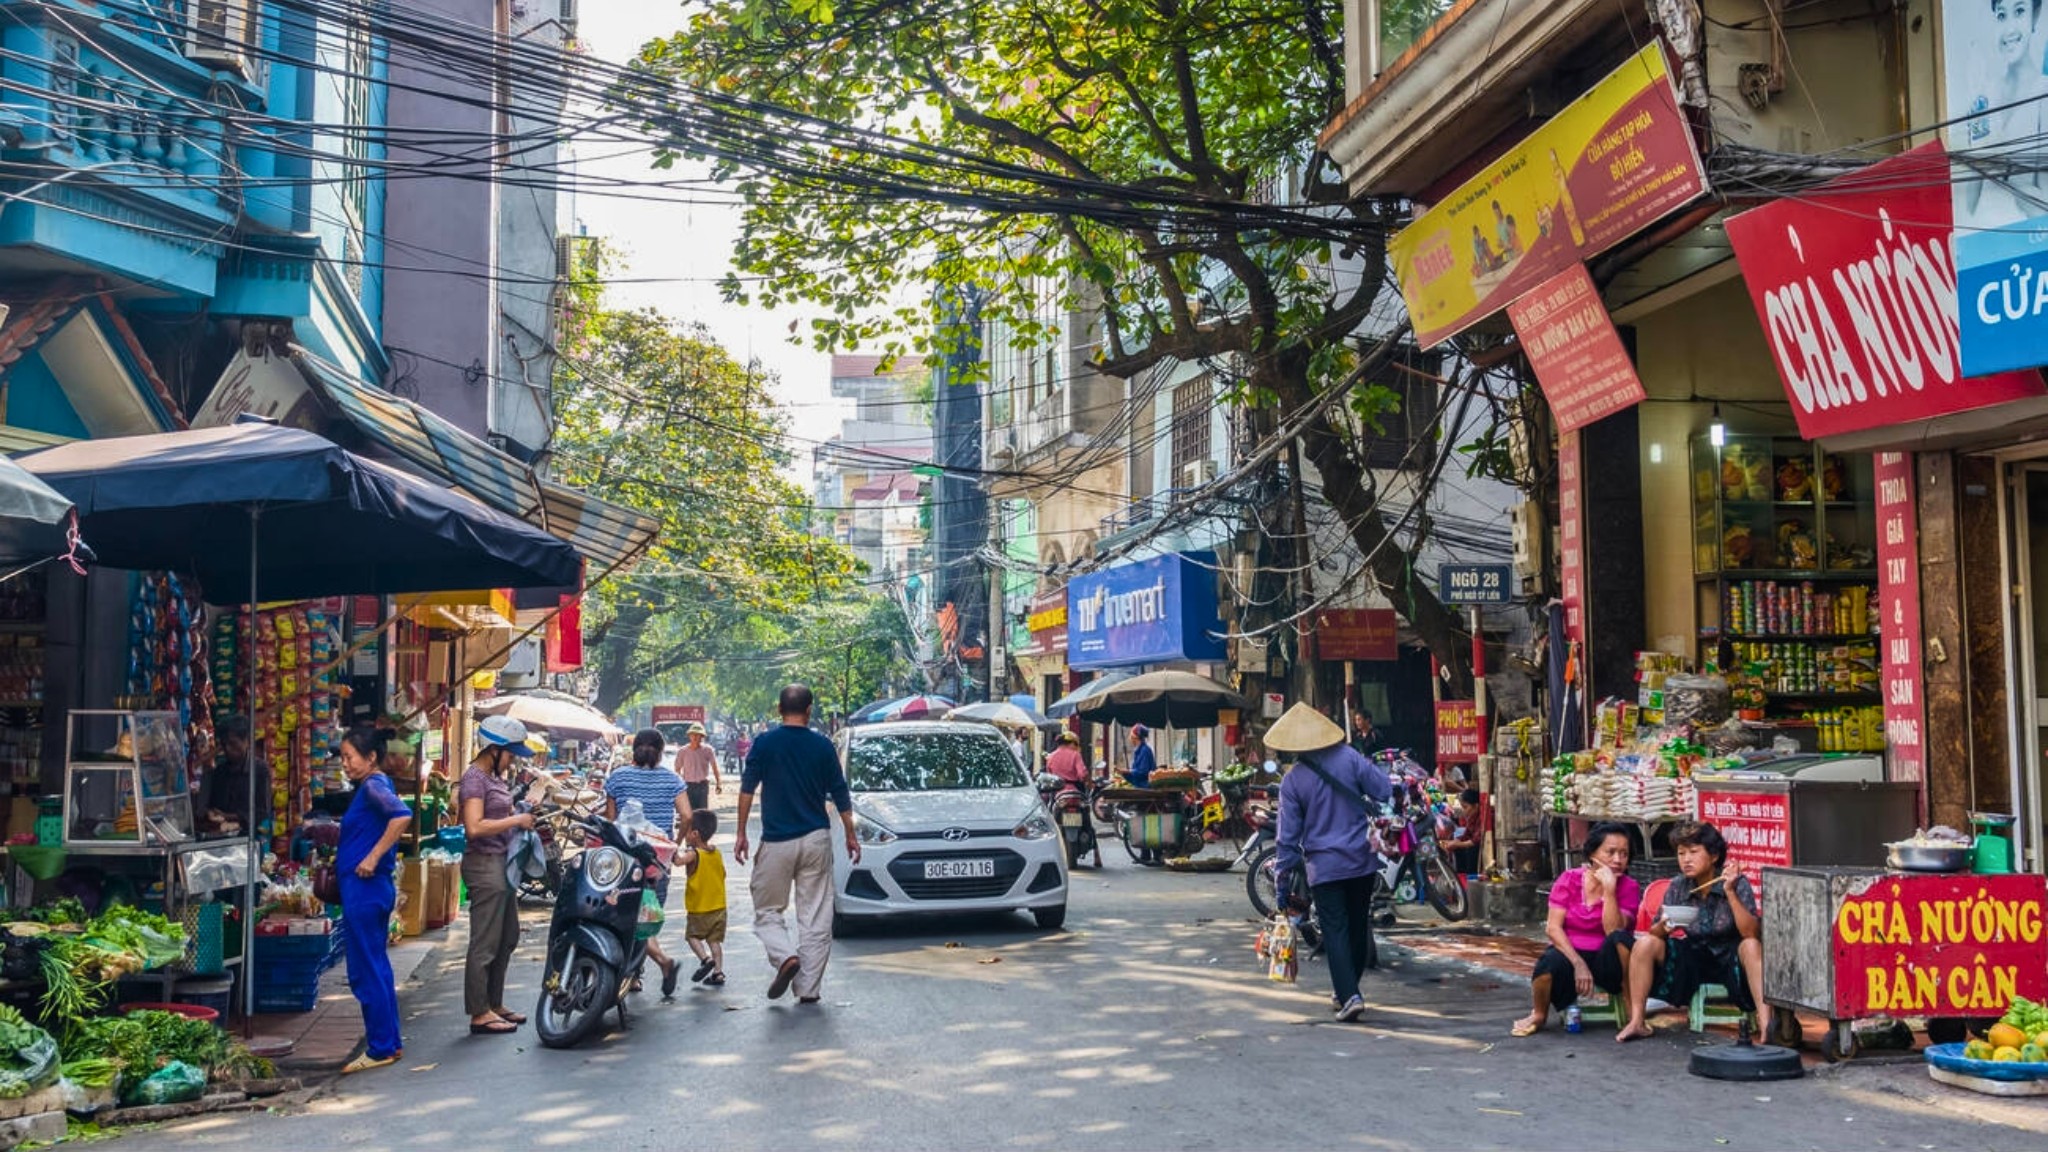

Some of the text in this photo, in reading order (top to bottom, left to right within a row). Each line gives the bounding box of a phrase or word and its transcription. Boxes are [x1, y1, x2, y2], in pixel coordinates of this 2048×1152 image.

[1765, 207, 1961, 413] CHẢ NƯỚN
[1880, 476, 1906, 506] THOA
[1451, 568, 1499, 588] NGÕ 28
[1887, 557, 1906, 585] TAY
[1894, 598, 1903, 624] &
[928, 861, 992, 877] 30E-021.16
[1838, 884, 2043, 944] CHẢ NƯỚNG
[1948, 953, 2018, 1009] CÂN
